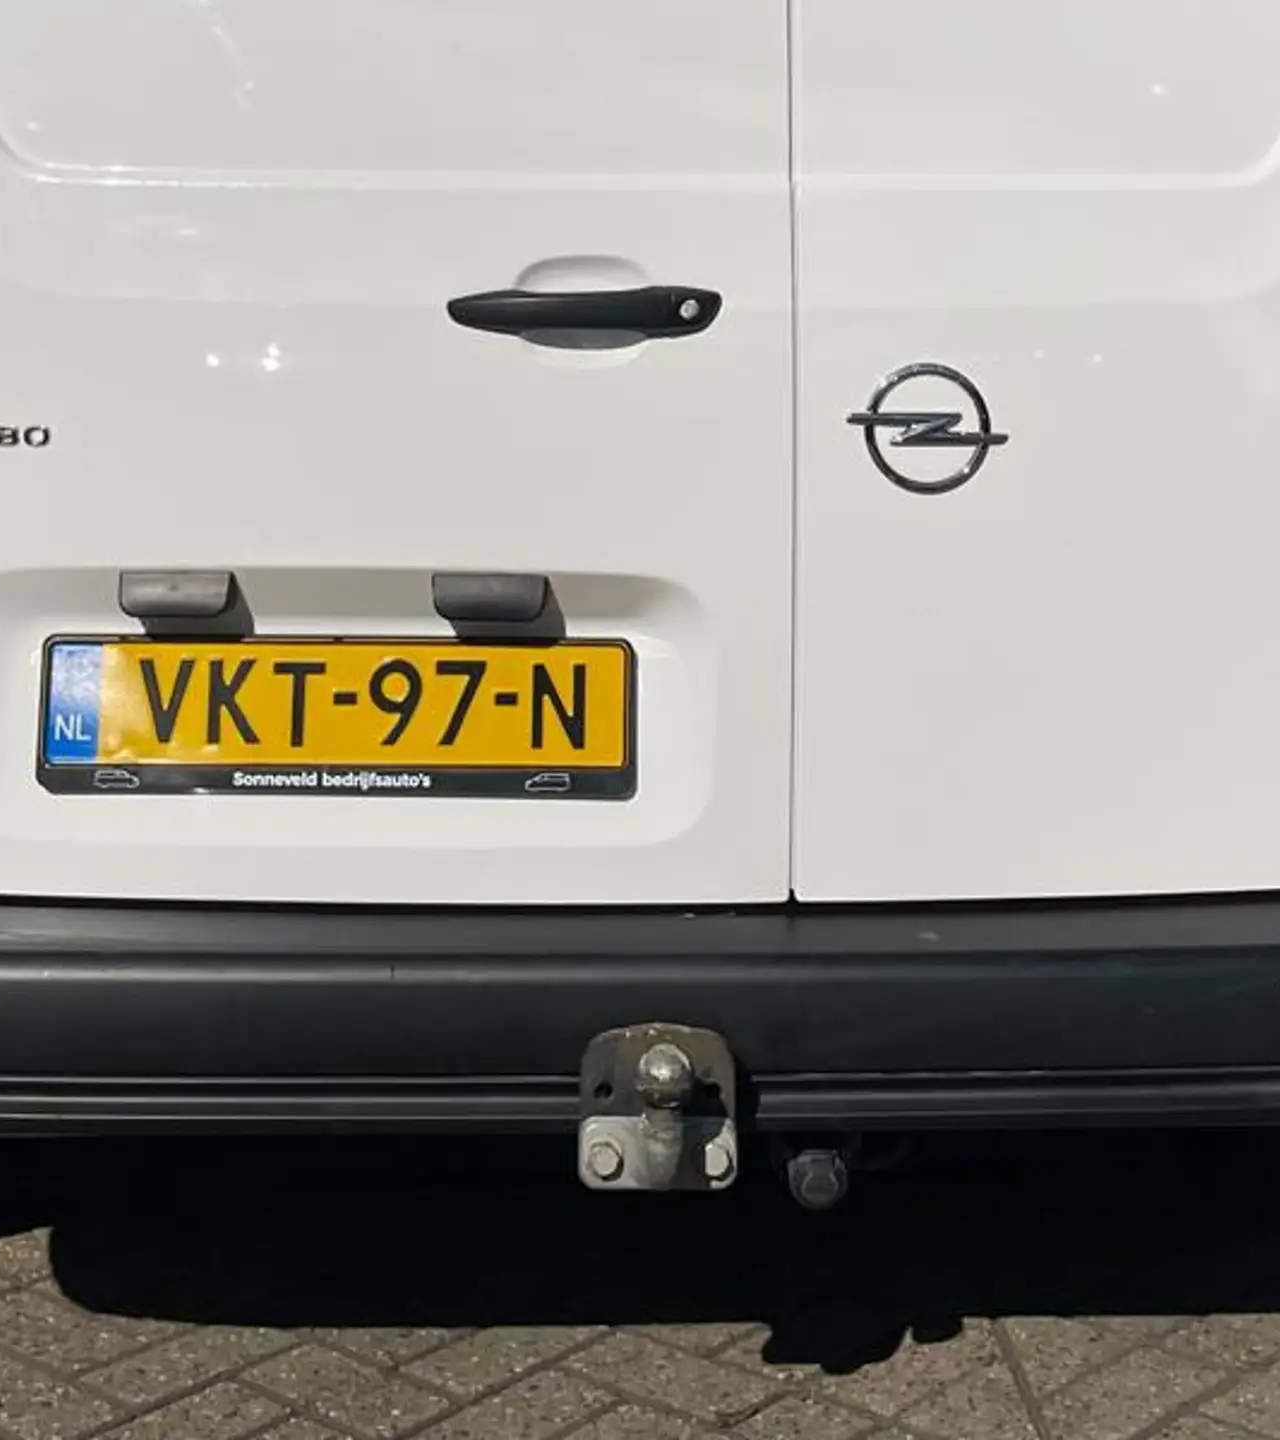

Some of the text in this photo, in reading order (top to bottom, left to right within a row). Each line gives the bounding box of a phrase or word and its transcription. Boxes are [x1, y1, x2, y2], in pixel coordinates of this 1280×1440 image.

[140, 659, 587, 750] VKT-97-N
[54, 714, 92, 741] NL
[232, 771, 431, 791] Sonneveld bedrijfsauto's
